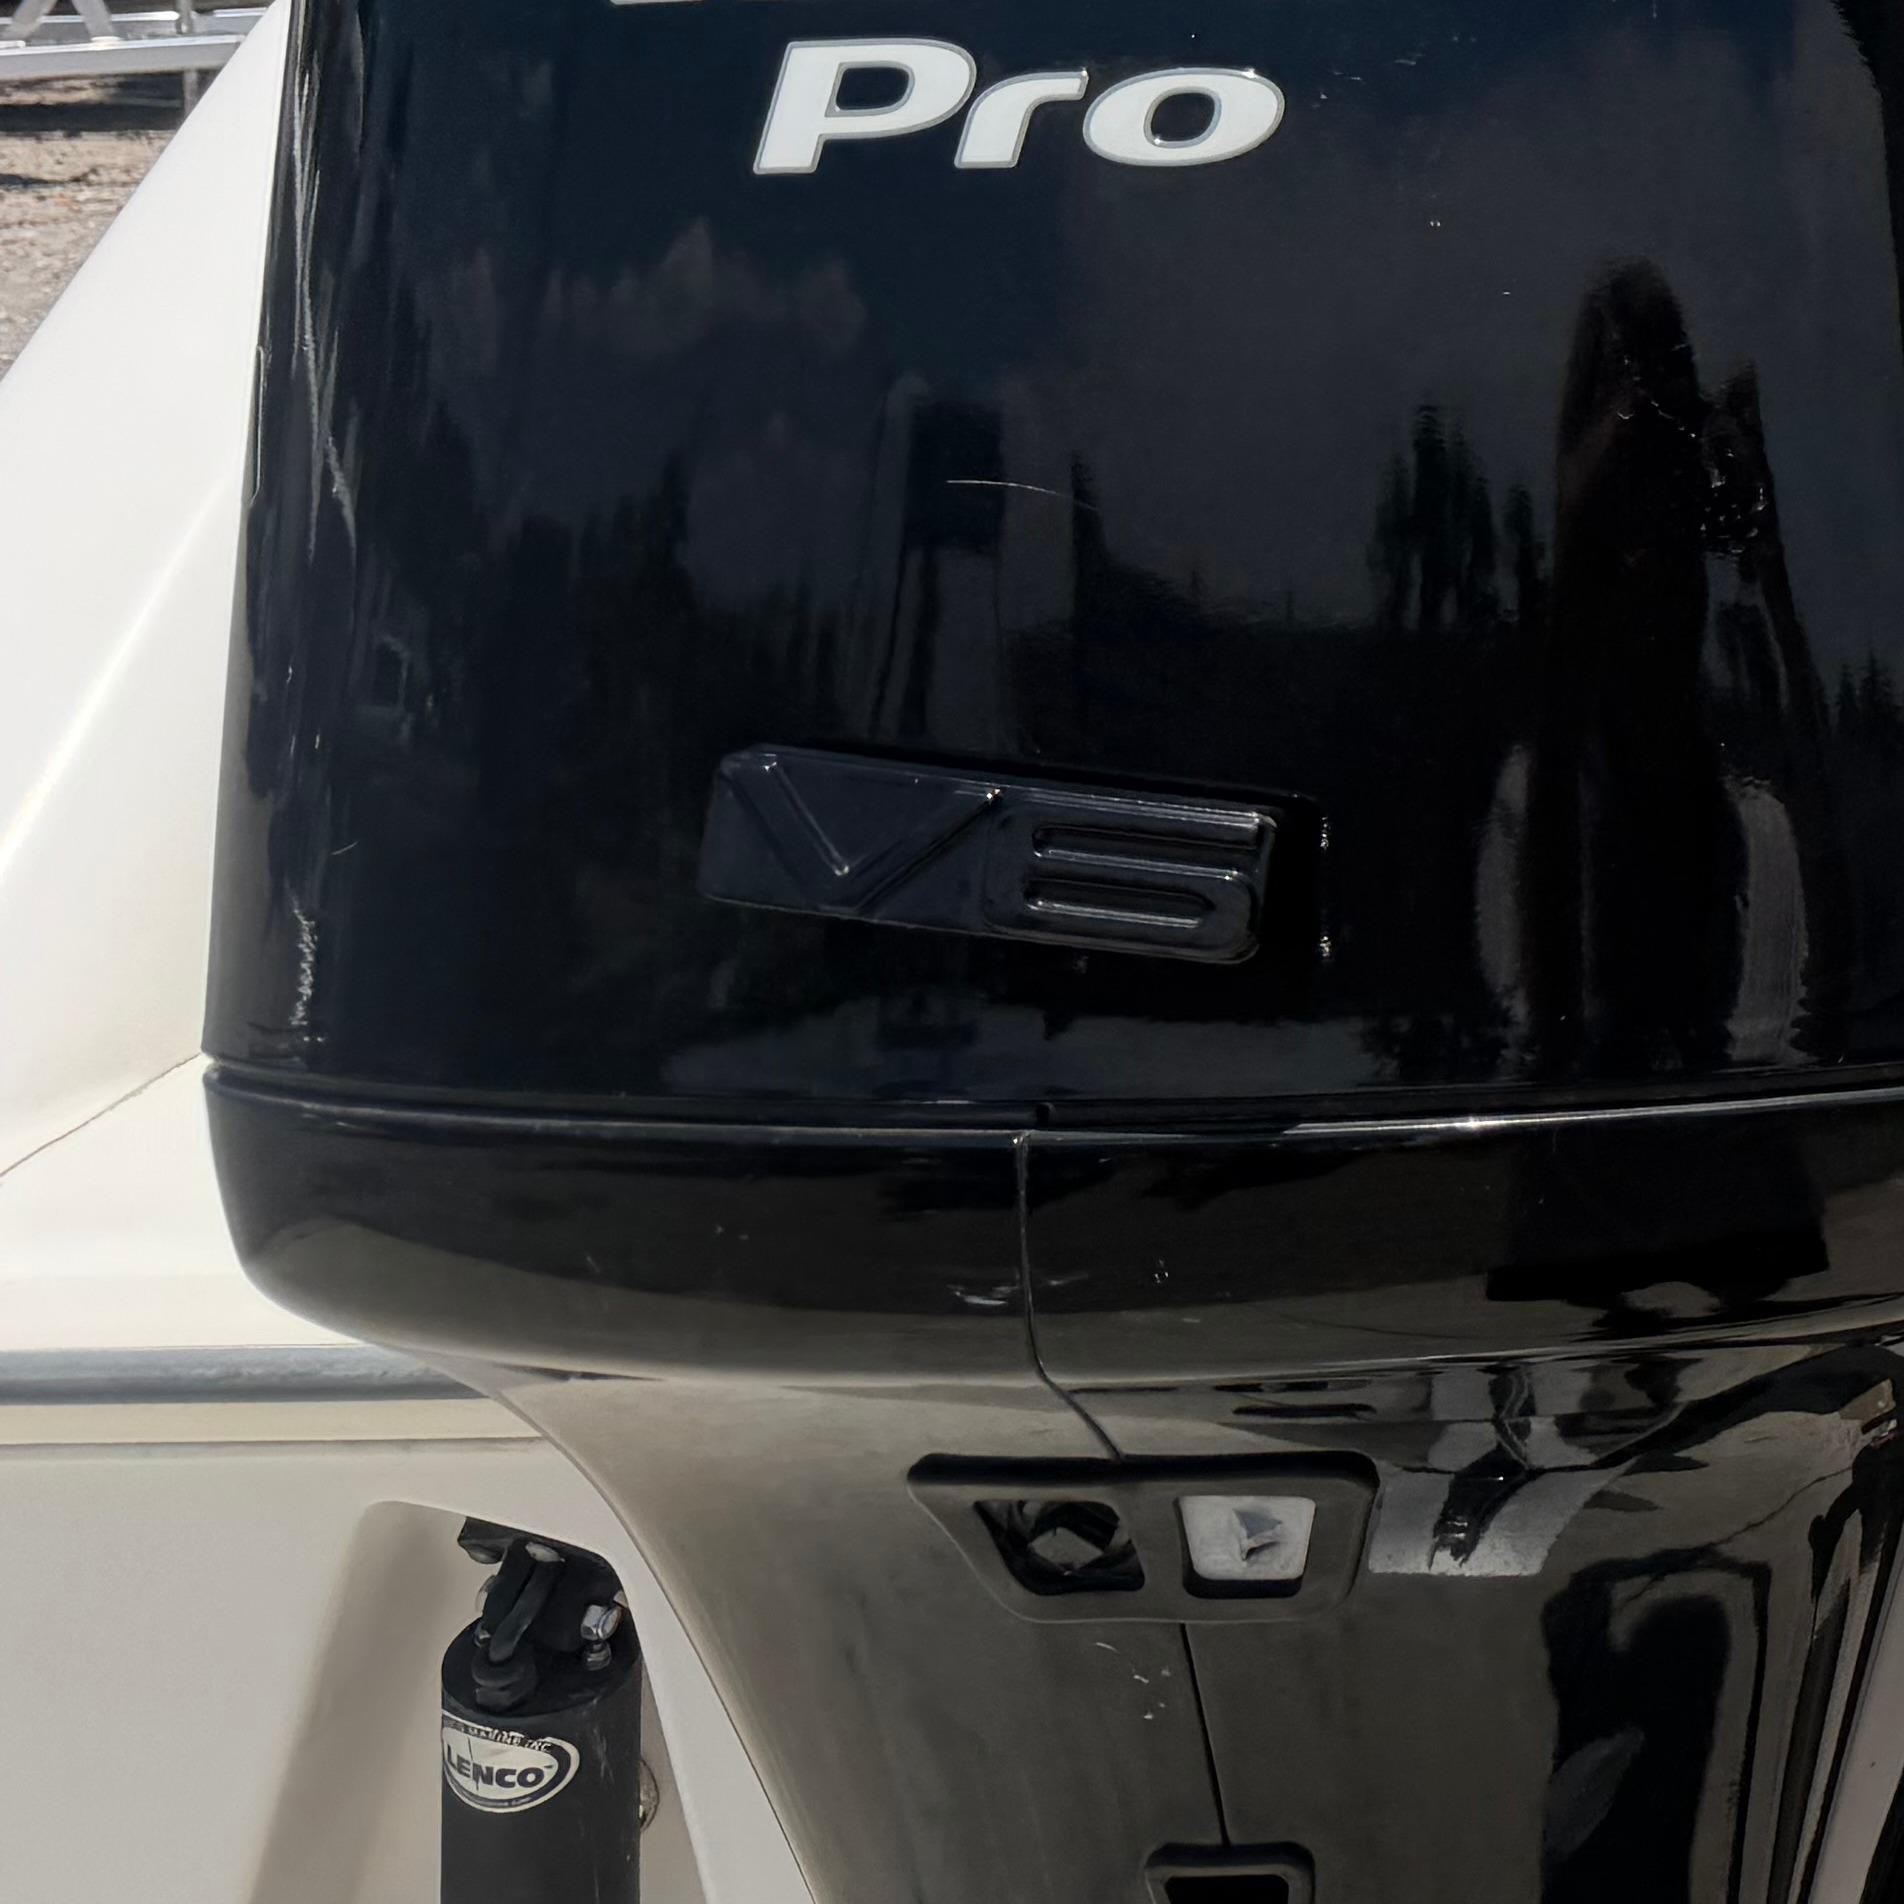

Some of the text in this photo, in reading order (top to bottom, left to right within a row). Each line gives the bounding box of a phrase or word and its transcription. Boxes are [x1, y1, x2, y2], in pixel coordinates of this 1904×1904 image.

[751, 36, 1287, 176] Pro
[716, 746, 1278, 964] V6
[446, 1743, 545, 1789] LENCO
